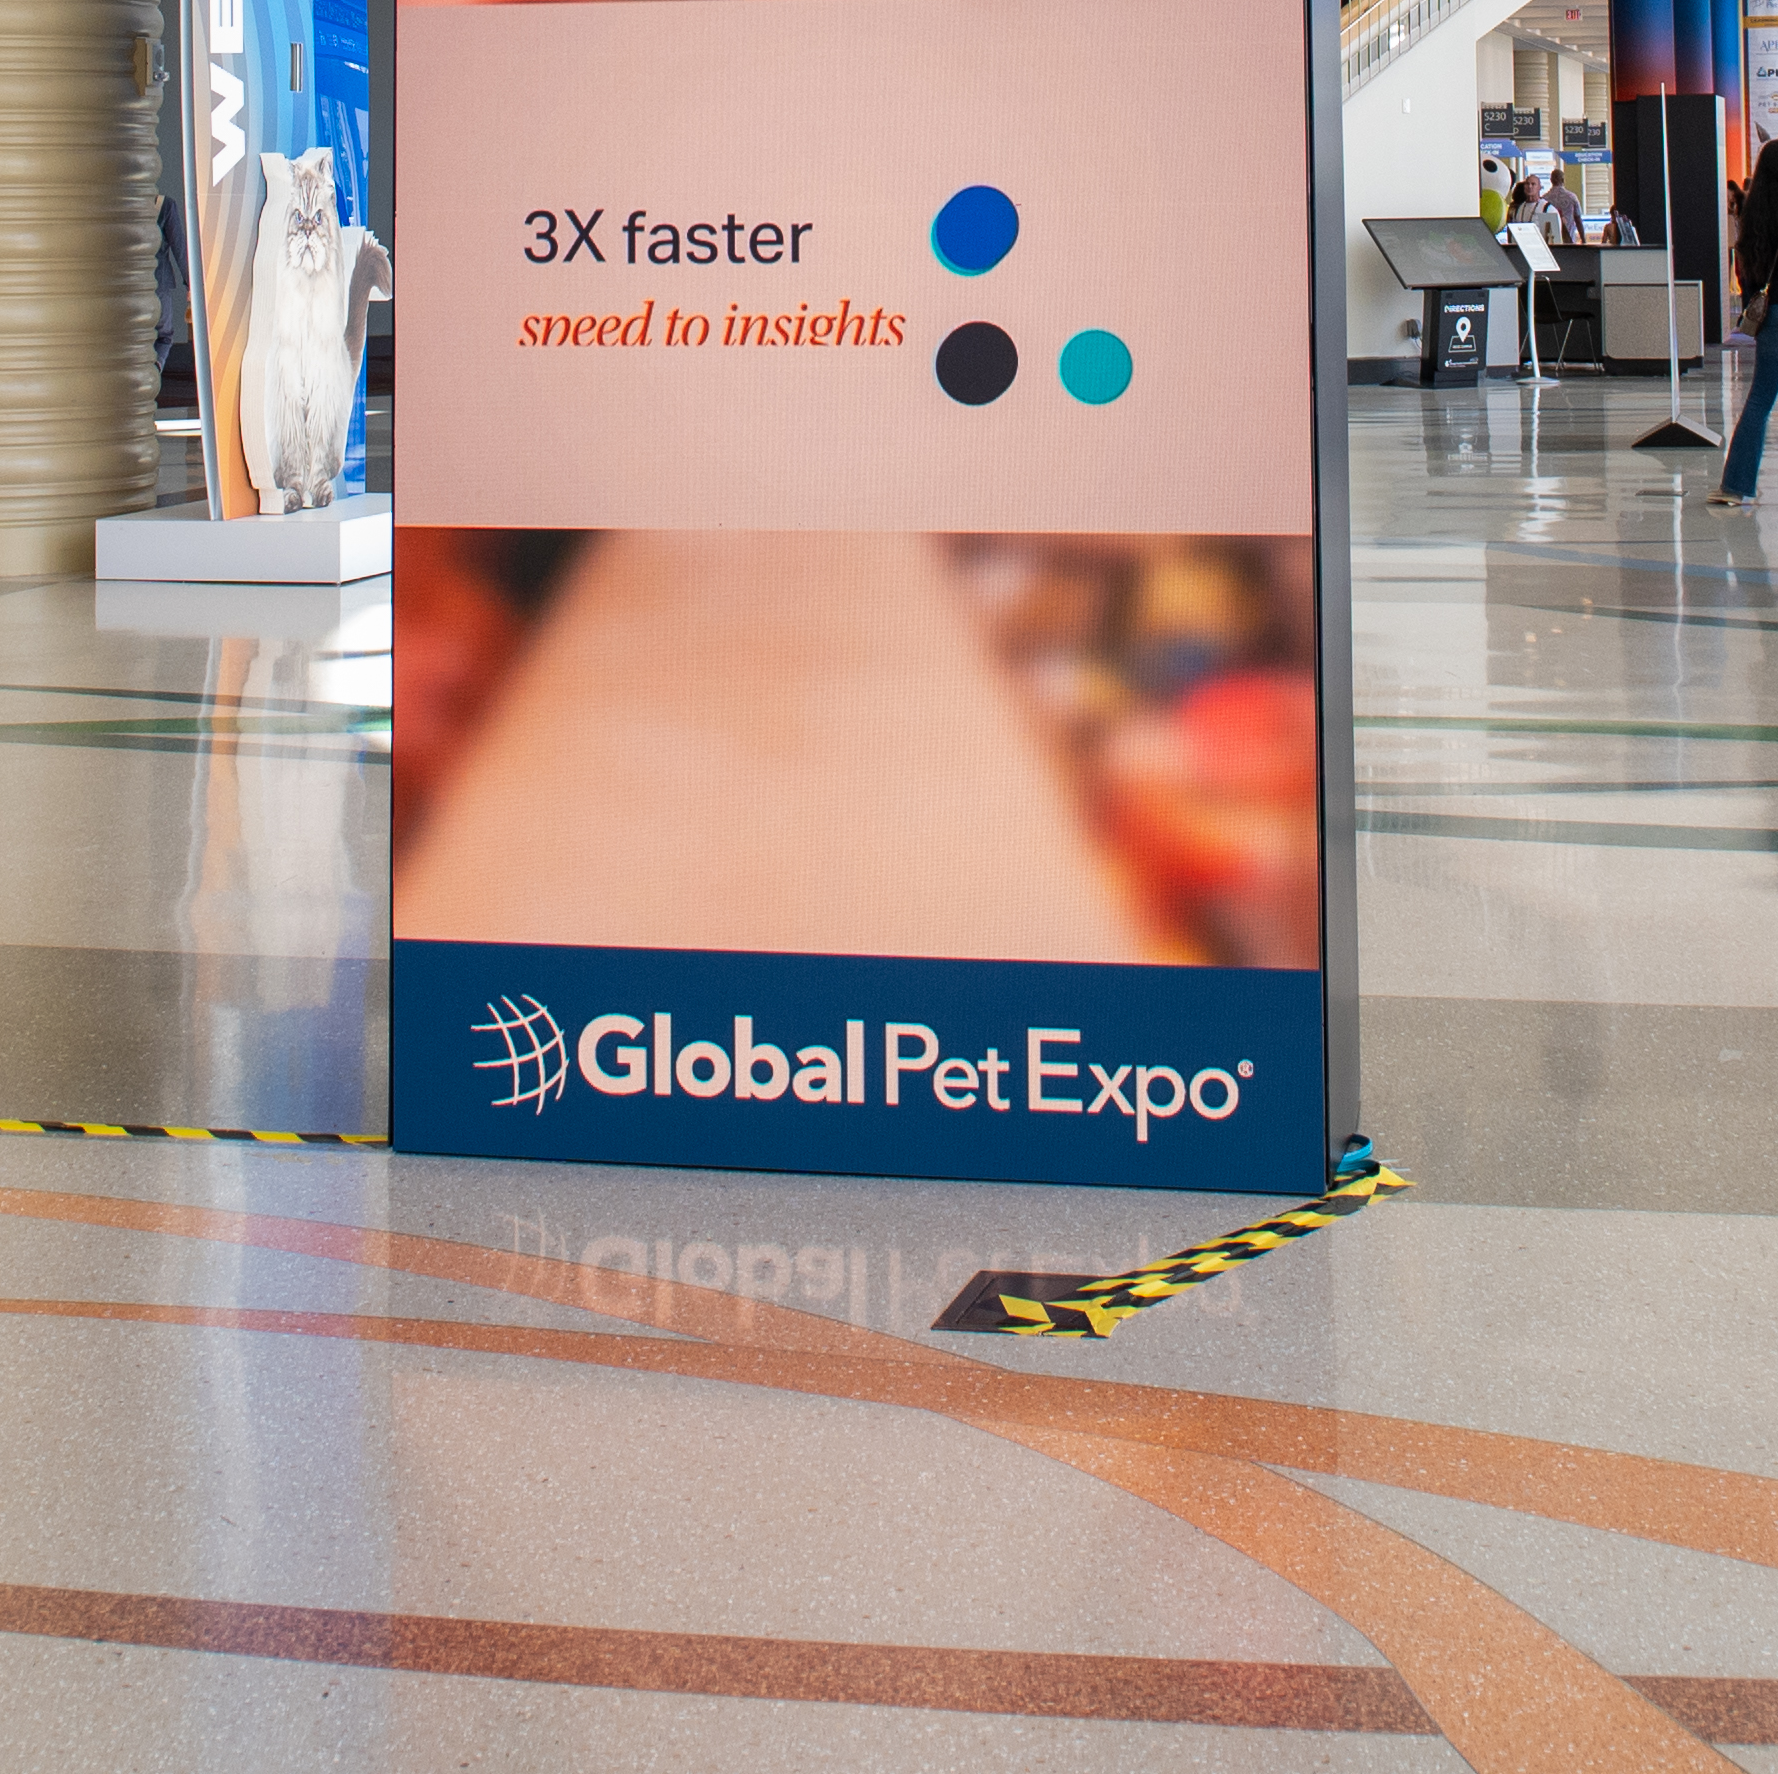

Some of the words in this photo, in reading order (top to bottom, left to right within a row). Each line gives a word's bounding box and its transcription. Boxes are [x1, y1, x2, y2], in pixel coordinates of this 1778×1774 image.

[1484, 112, 1507, 122] S230
[523, 208, 607, 265] 3X
[622, 209, 814, 265] faster
[665, 305, 711, 347] to
[723, 297, 907, 347] insights
[576, 1011, 865, 1106] Global
[885, 1022, 1011, 1112] Pet
